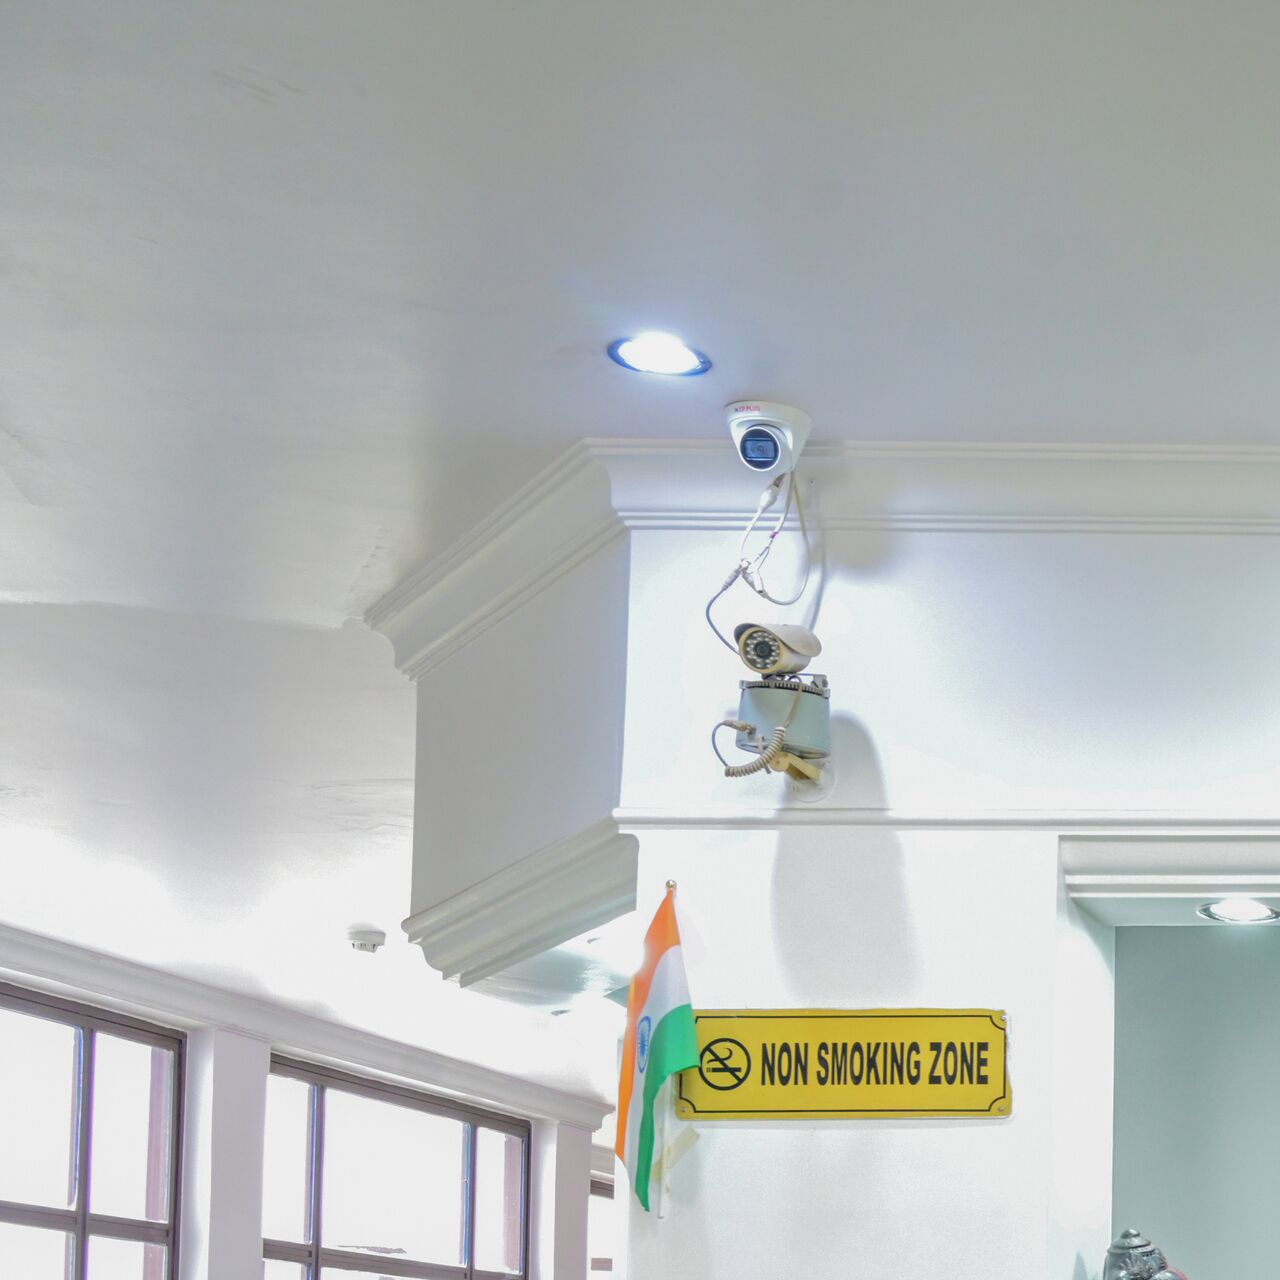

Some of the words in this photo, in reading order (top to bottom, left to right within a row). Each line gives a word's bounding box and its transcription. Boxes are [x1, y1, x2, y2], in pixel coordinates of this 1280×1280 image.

[761, 1041, 808, 1086] NON
[816, 1041, 921, 1086] SMOKING
[928, 1041, 989, 1085] ZONE
